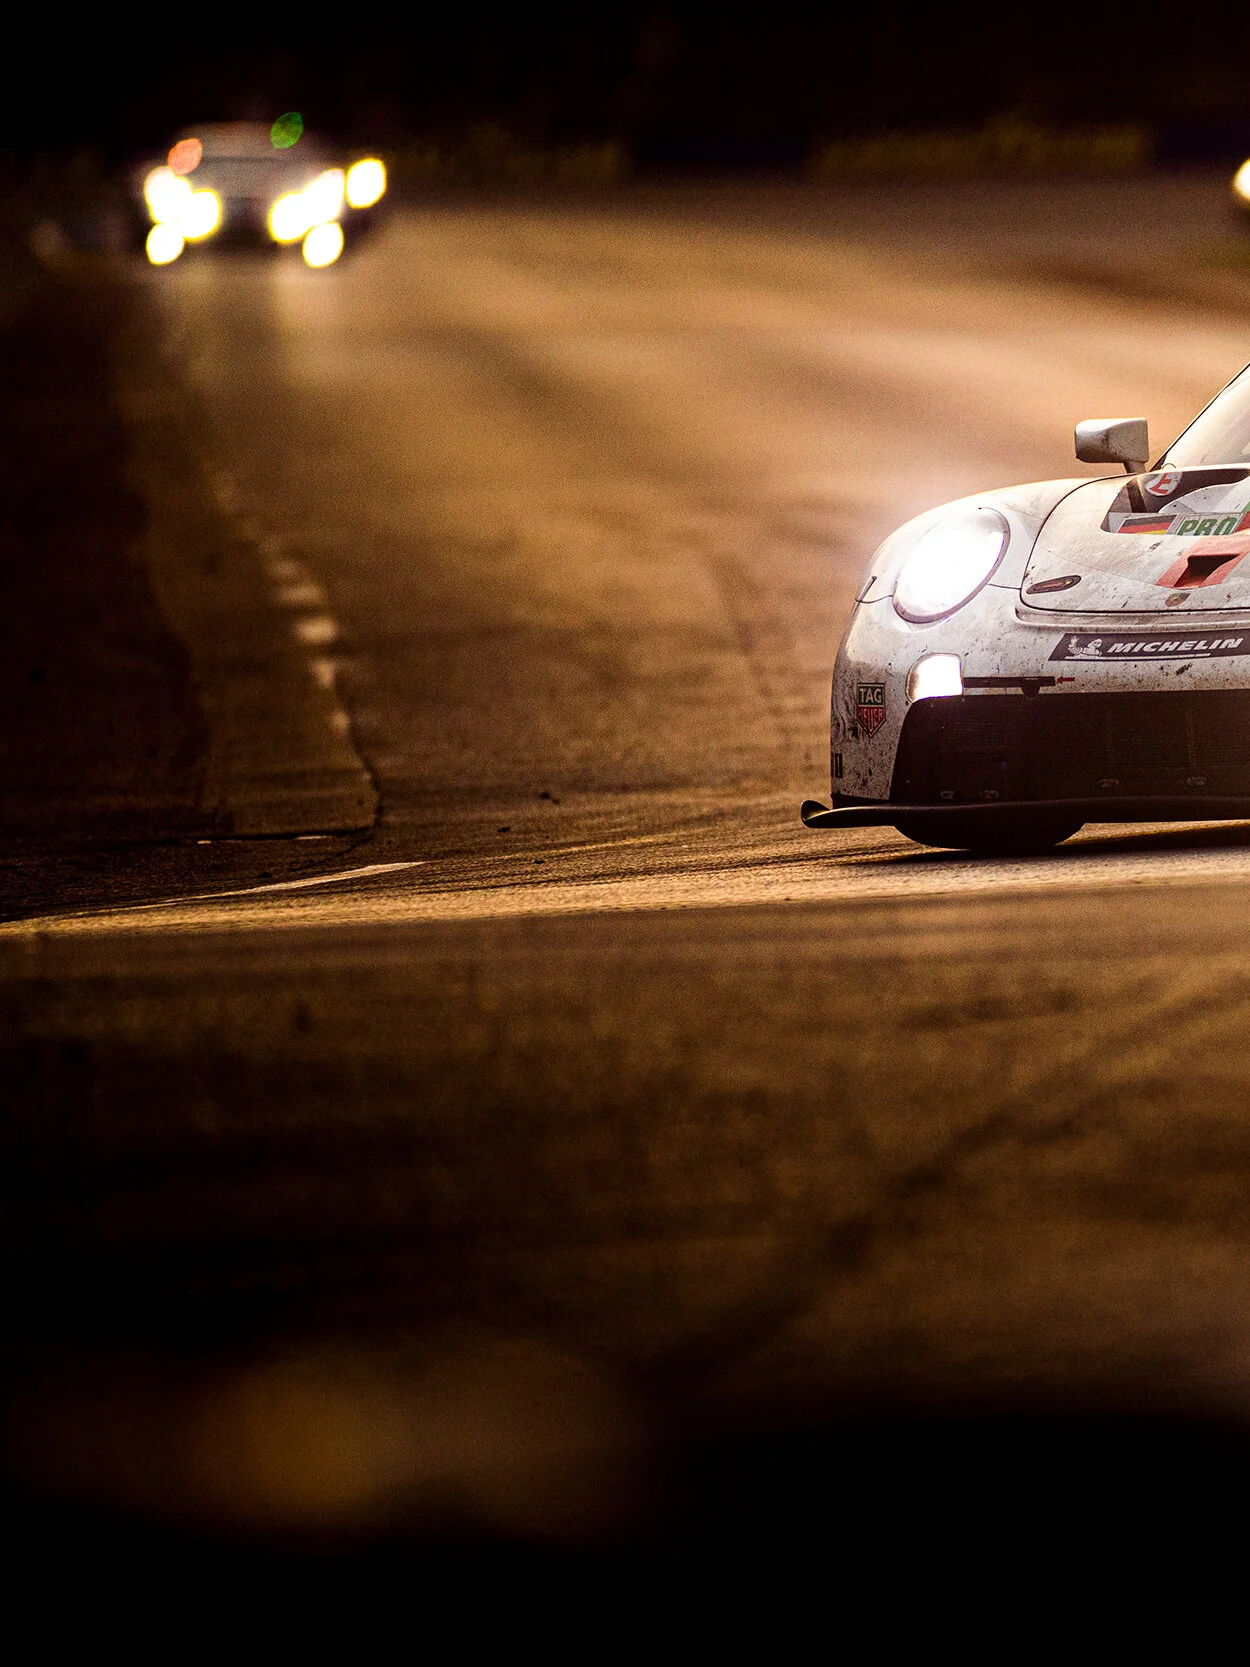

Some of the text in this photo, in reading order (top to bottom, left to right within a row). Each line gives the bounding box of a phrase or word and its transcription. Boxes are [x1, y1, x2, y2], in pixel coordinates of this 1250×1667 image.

[1177, 517, 1238, 536] PRO
[1107, 637, 1244, 653] MICHELIN
[859, 687, 882, 704] TAG
